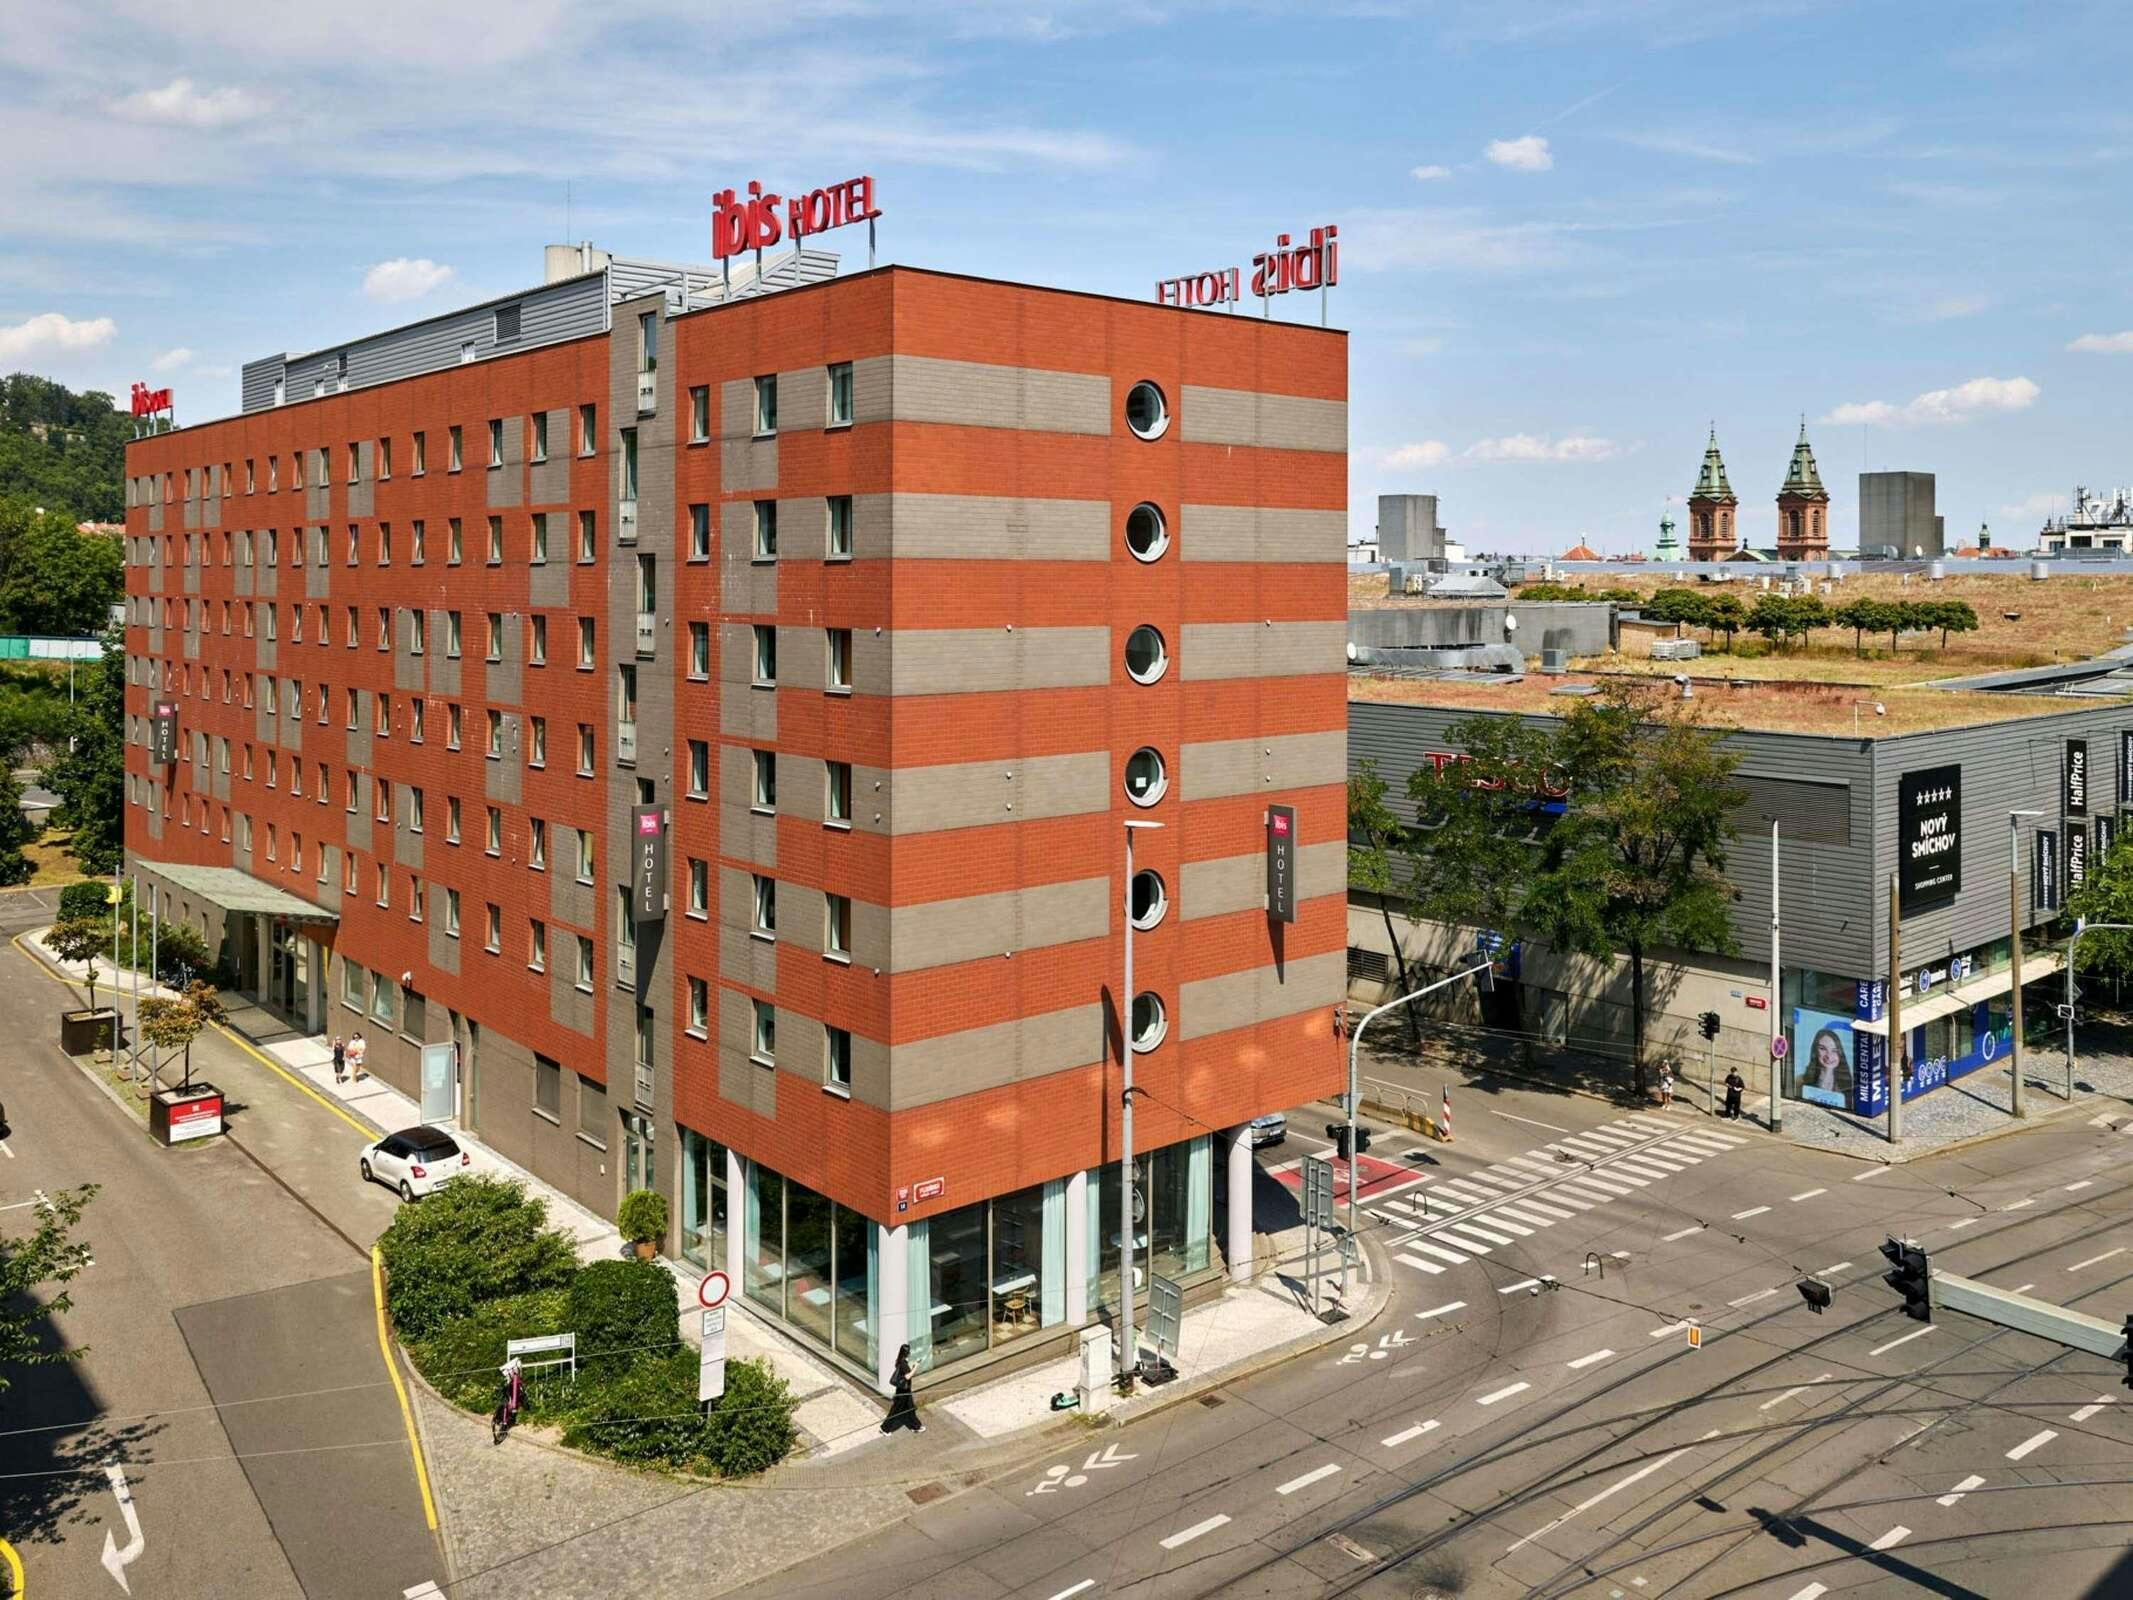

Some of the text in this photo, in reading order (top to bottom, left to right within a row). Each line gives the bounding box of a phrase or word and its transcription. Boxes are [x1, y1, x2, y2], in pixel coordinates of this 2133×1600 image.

[713, 176, 882, 259] ibis HOTEL
[2071, 752, 2083, 805] HalfPrice
[1912, 833, 1956, 858] SMÍCHOV
[1920, 812, 1948, 837] NOVÝ
[644, 843, 654, 912] HOTEL
[1277, 844, 1285, 913] HOTEL
[1859, 980, 1869, 1102] MILES DENTAL CARE
[1872, 1034, 1881, 1102] MILES
